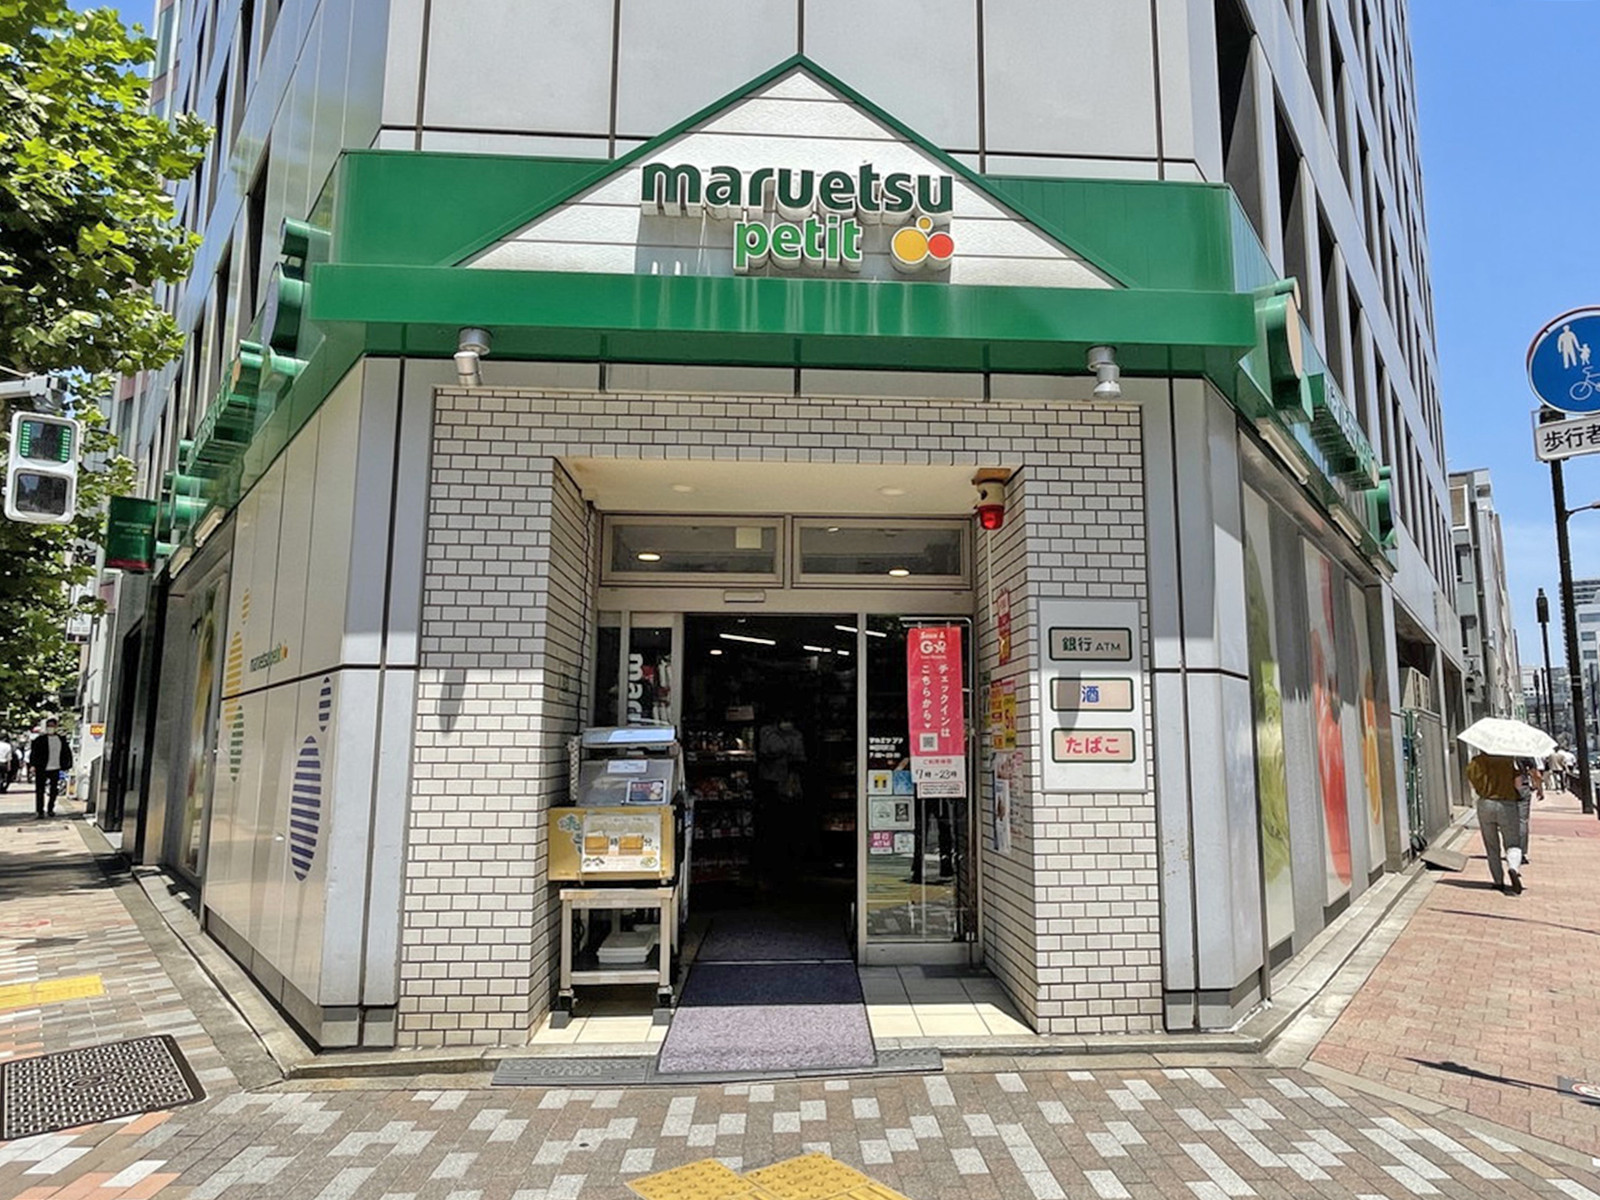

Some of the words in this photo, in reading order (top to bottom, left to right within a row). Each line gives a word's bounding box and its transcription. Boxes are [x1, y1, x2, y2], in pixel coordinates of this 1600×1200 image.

[641, 162, 954, 214] maruetsu
[734, 214, 863, 271] petit
[1544, 423, 1600, 452] 歩行者
[1062, 637, 1092, 651] 銀行
[1095, 643, 1120, 651] ATM
[939, 664, 950, 737] チェックインは
[1081, 685, 1100, 703] 酒
[1065, 737, 1120, 754] たばこ
